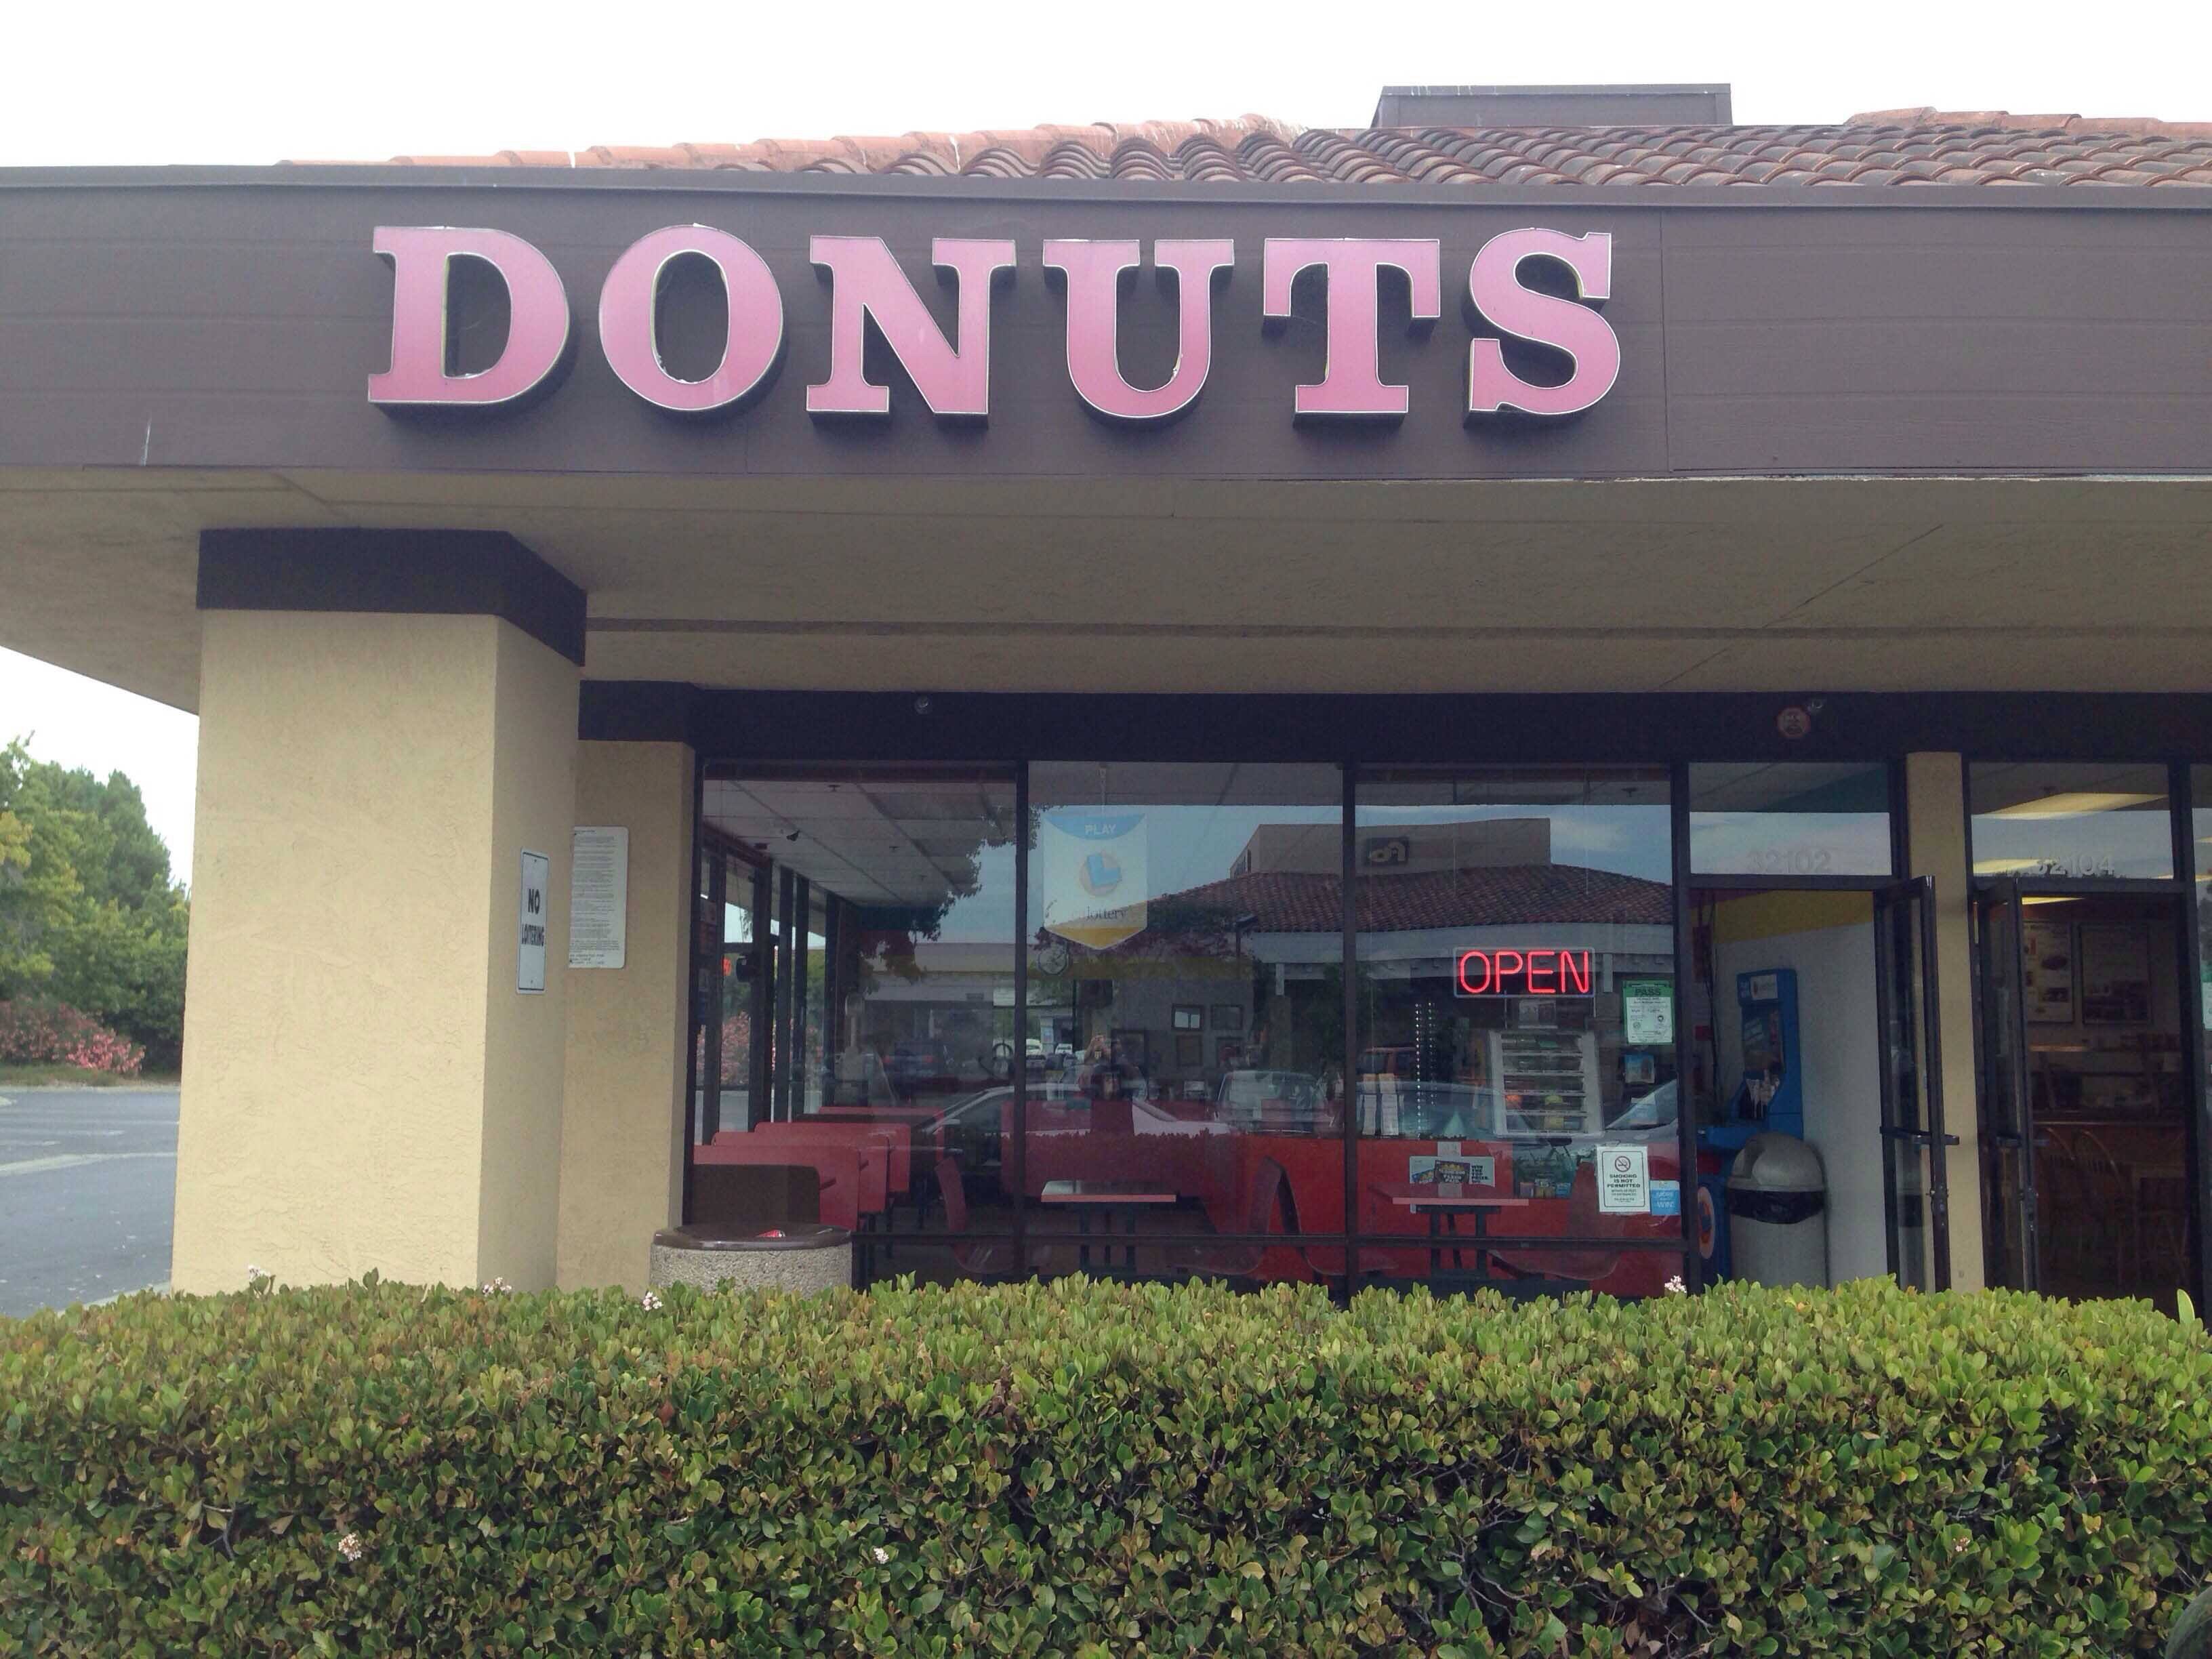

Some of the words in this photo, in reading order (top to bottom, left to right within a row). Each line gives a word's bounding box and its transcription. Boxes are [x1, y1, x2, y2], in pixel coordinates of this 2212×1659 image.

[367, 224, 1620, 418] DONUTS
[1084, 823, 1116, 834] PLAY
[2035, 851, 2115, 875] 32104
[528, 888, 540, 914] NO
[521, 924, 544, 946] LOITERING
[1459, 950, 1589, 994] OPEN
[1634, 986, 1660, 996] PASS
